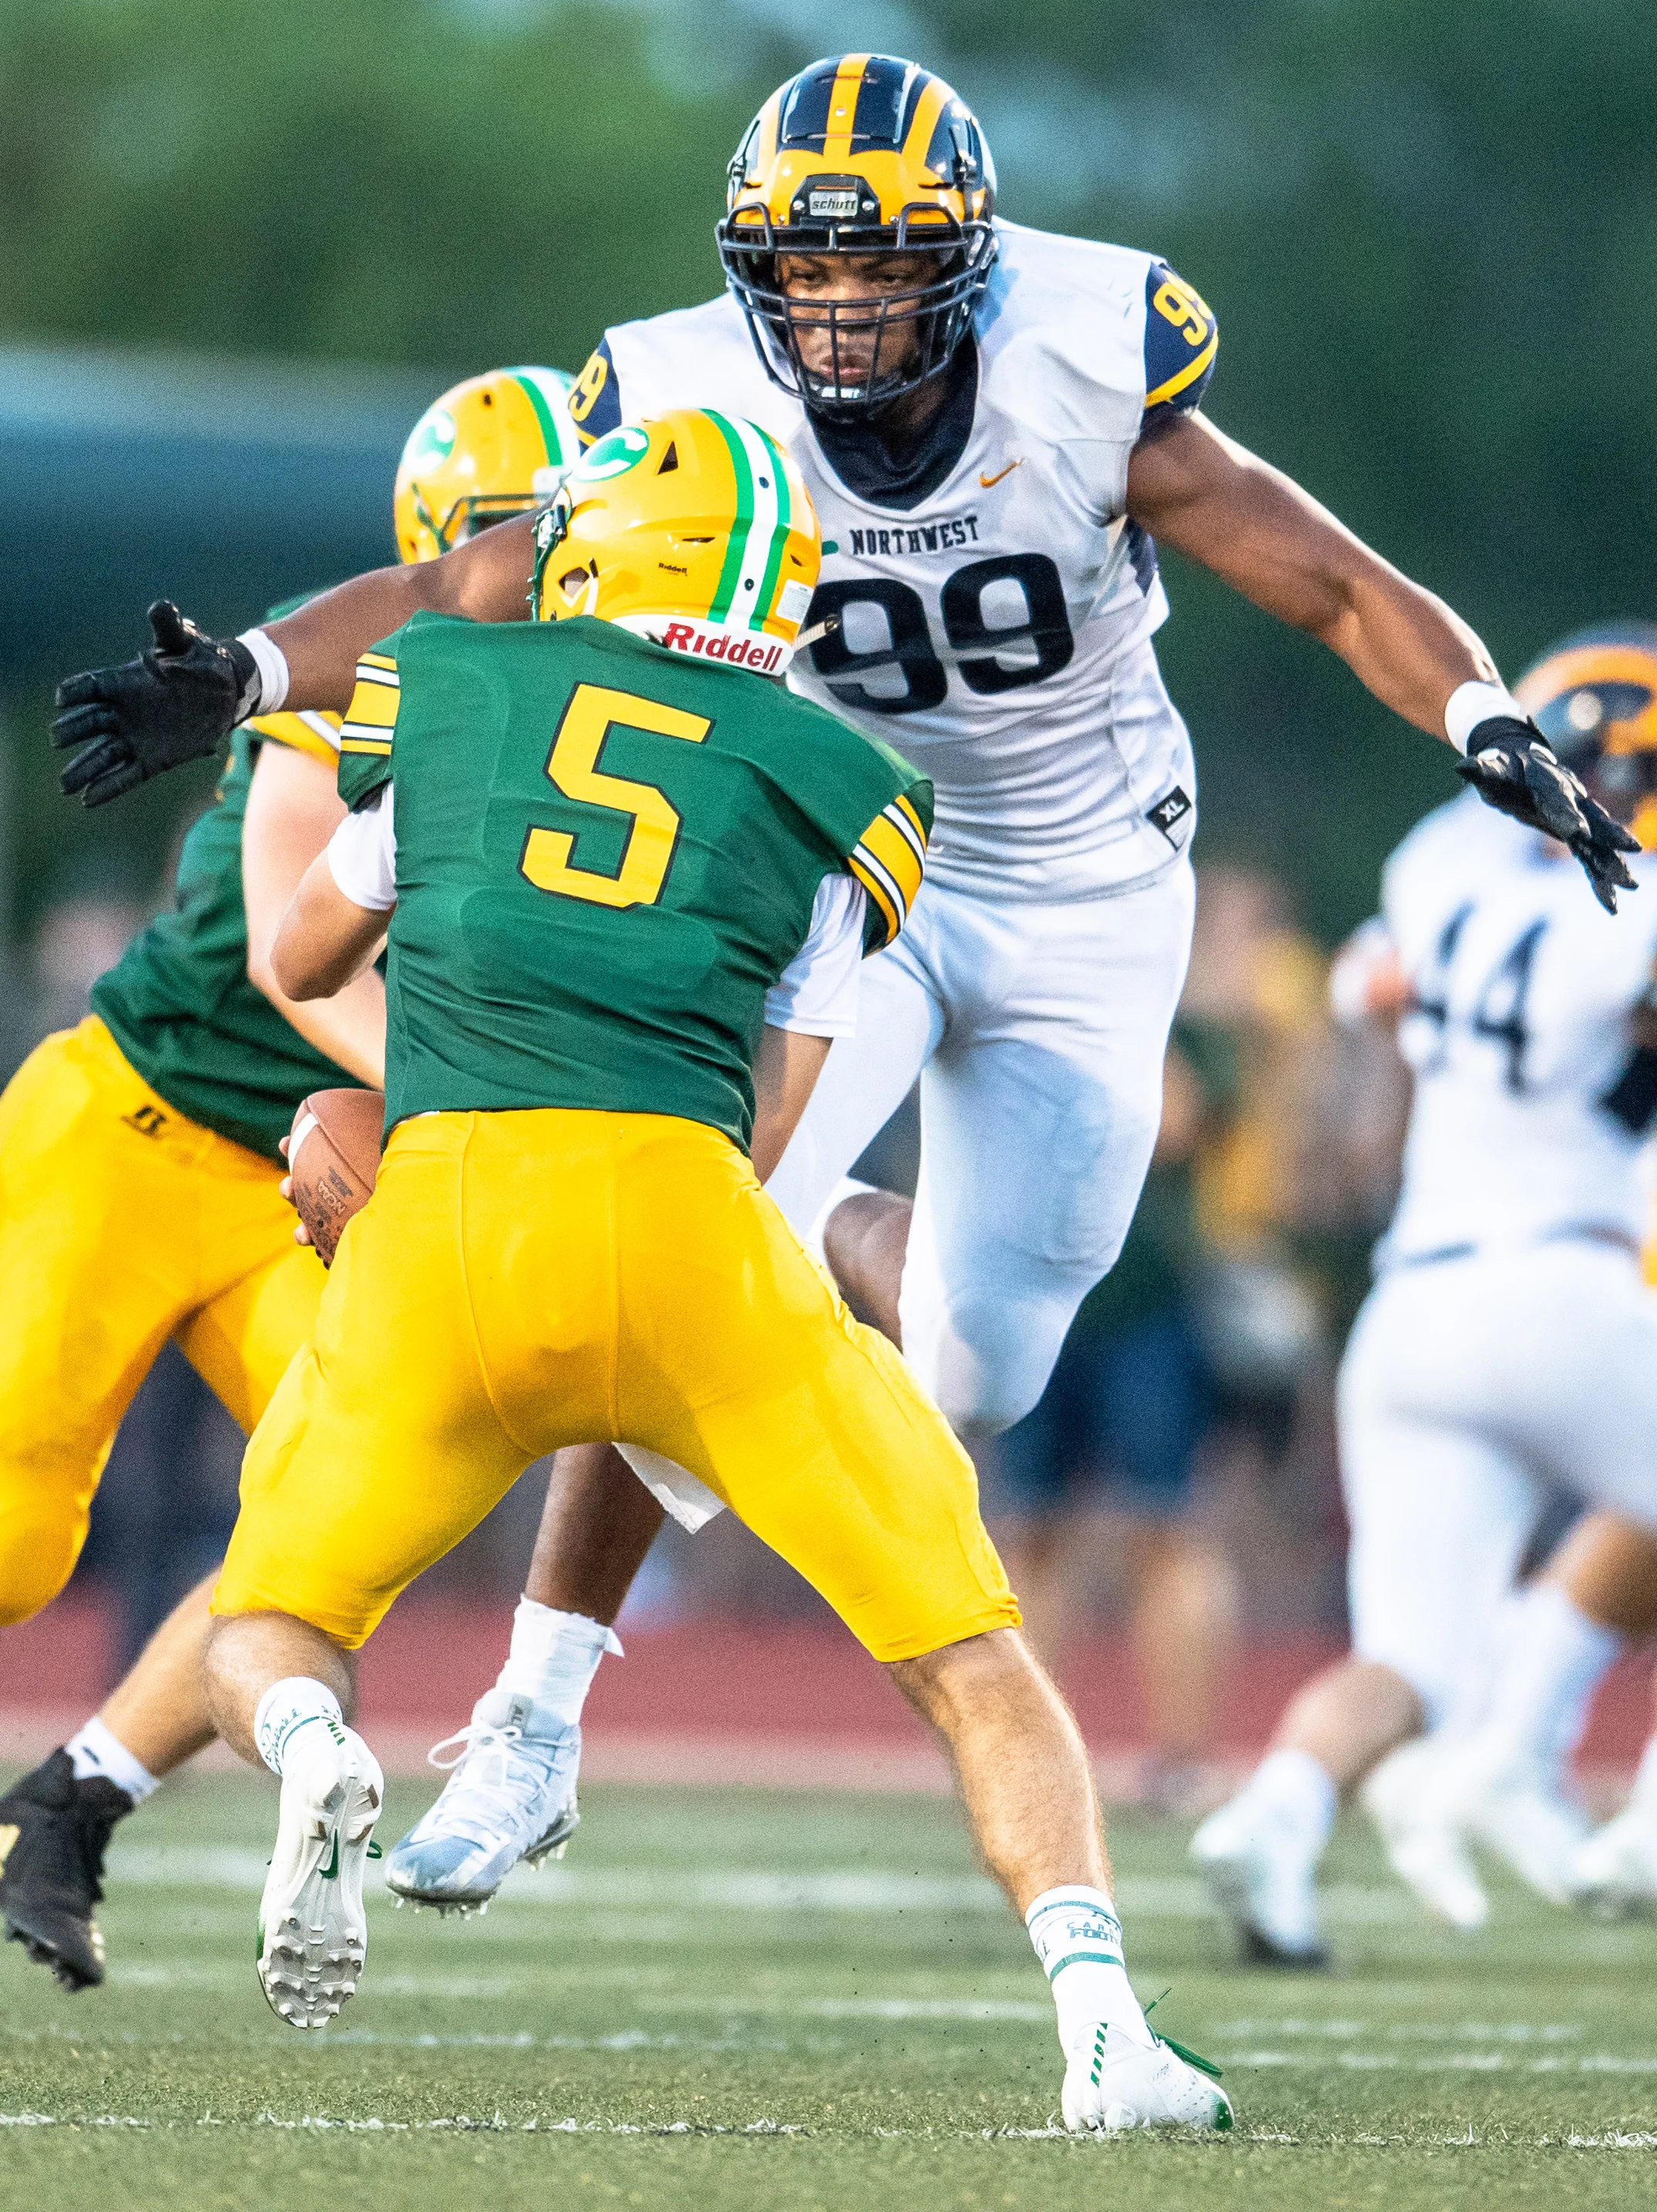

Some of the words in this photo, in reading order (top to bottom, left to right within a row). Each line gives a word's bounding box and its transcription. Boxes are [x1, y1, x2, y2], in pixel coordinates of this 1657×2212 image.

[812, 197, 857, 210] schutt
[849, 515, 978, 556] NORTHWEST
[664, 623, 783, 672] Riddell
[810, 553, 1074, 714] 99
[516, 681, 718, 913] 5
[1158, 799, 1185, 822] XL
